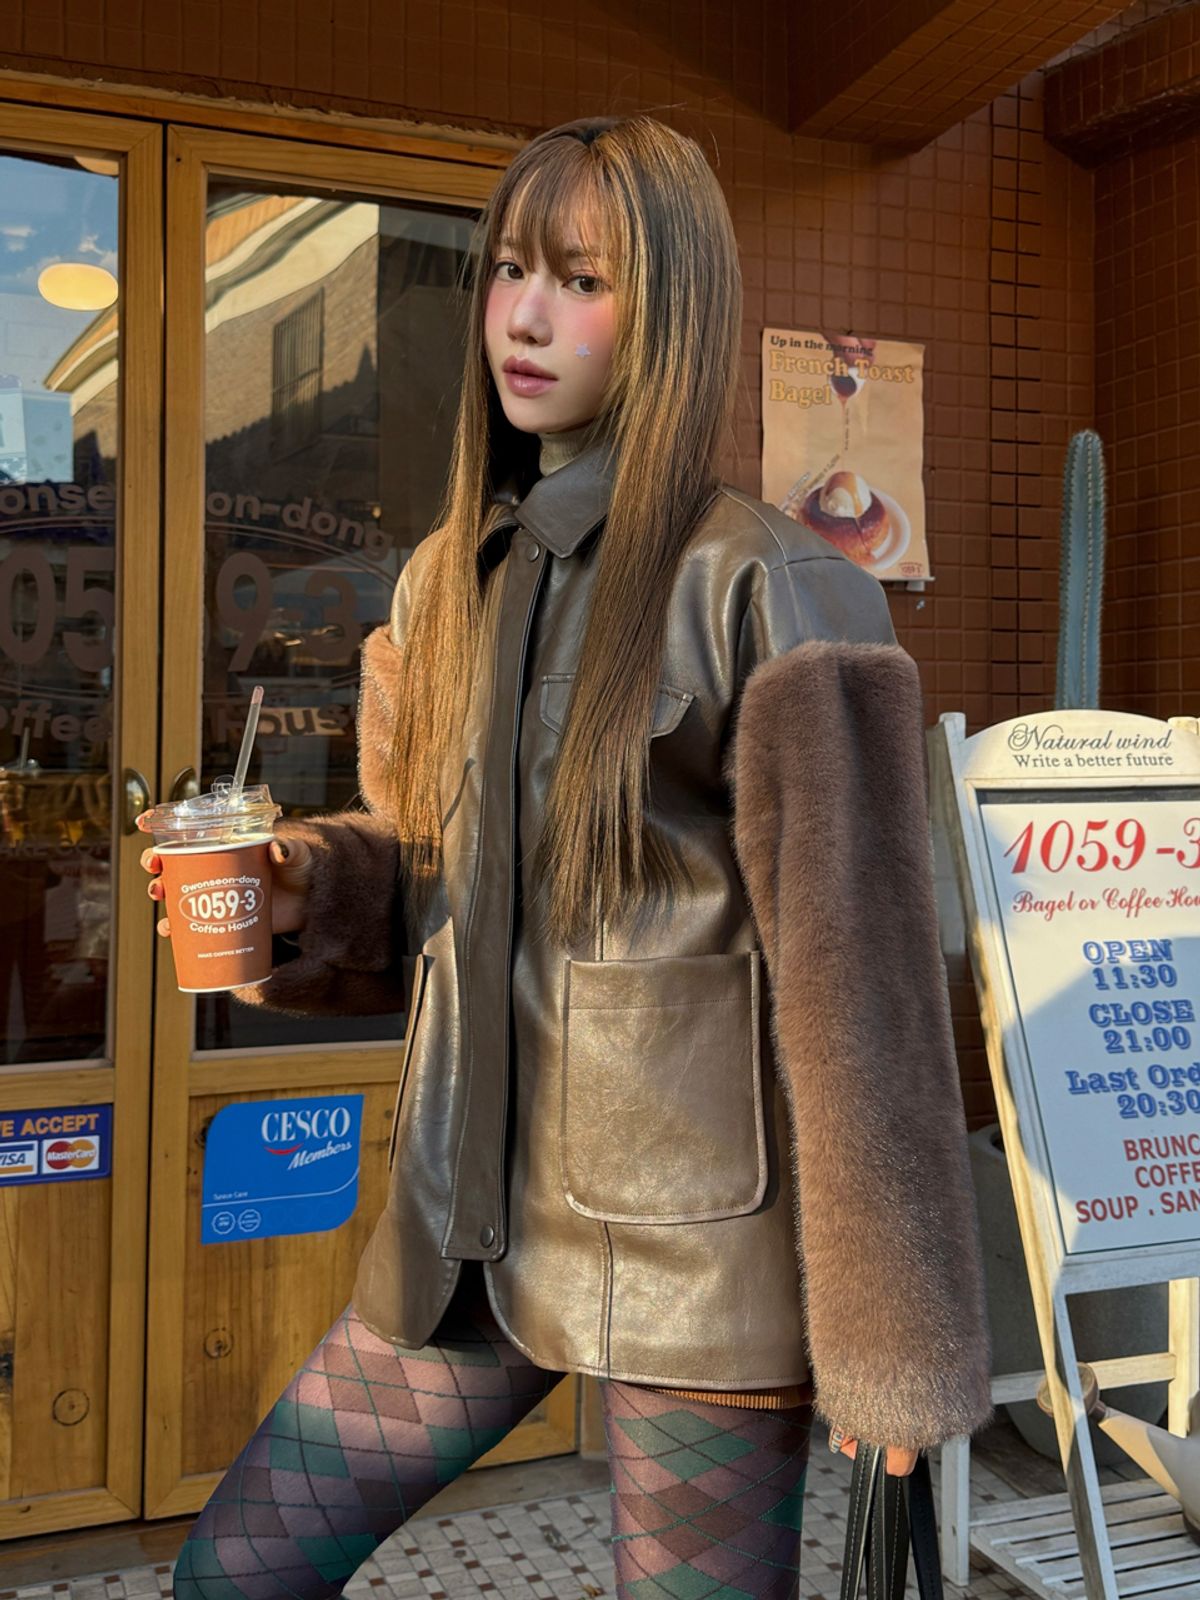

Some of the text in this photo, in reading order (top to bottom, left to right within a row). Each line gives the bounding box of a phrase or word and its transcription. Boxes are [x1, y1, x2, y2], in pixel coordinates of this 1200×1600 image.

[770, 336, 873, 357] Up in the morning
[769, 350, 914, 384] French Toast
[769, 379, 832, 409] Bagel
[1008, 722, 1172, 751] Natural wind
[1013, 751, 1173, 768] Write a better future
[181, 875, 260, 894] Gwonseon-dong
[188, 889, 256, 919] 1059-3
[1013, 890, 1074, 922] Bagel
[1078, 897, 1100, 910] or
[1102, 887, 1162, 919] Coffee
[189, 915, 258, 934] Coffee House
[1083, 938, 1173, 964] OPEN
[1092, 964, 1177, 990] 11:30
[1088, 999, 1195, 1027] CLOSE
[1103, 1025, 1191, 1053] 21:00
[1065, 1067, 1140, 1095] Last
[1117, 1089, 1200, 1119] 20:30
[0, 1113, 99, 1137] E ACCEPT
[261, 1107, 351, 1142] CESCO
[287, 1141, 353, 1170] Members
[1123, 1133, 1200, 1162] BRUNC
[1075, 1196, 1139, 1224] SOUP
